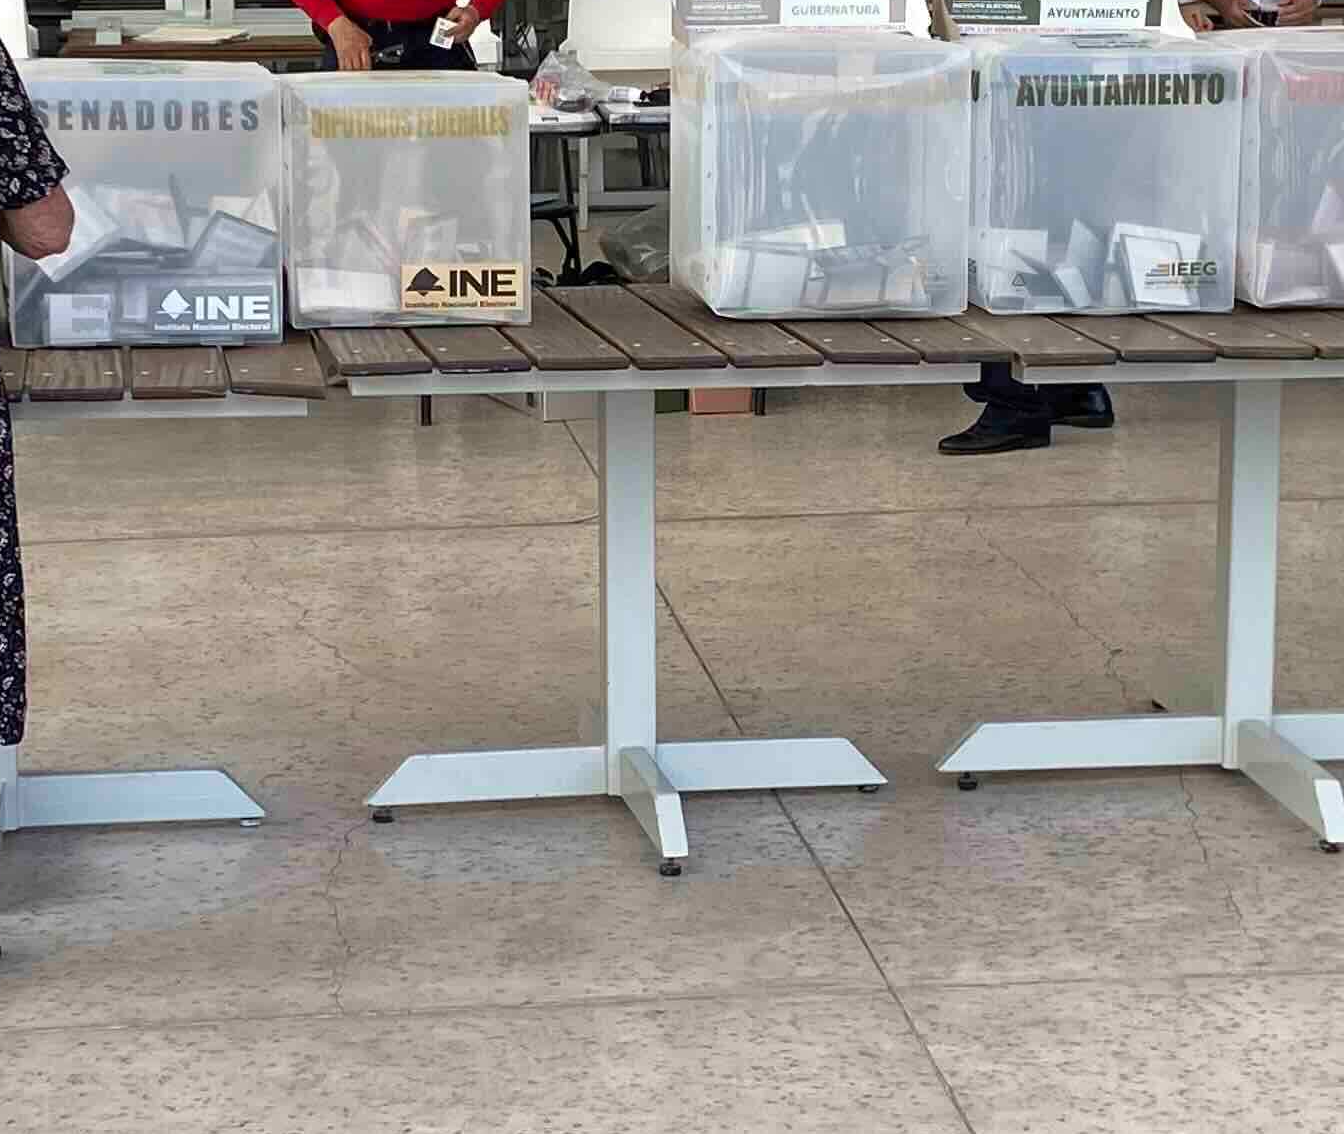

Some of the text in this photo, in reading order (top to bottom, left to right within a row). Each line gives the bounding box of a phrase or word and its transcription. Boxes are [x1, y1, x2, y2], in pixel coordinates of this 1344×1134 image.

[792, 4, 880, 17] GUBERNATURA
[1047, 7, 1141, 20] AYUNTAMIENTO
[1015, 73, 1225, 107] AYUNTAMIENTO
[37, 98, 258, 132] SENADORES
[1171, 261, 1217, 276] IEEG
[449, 268, 517, 297] INE
[195, 295, 271, 322] INE
